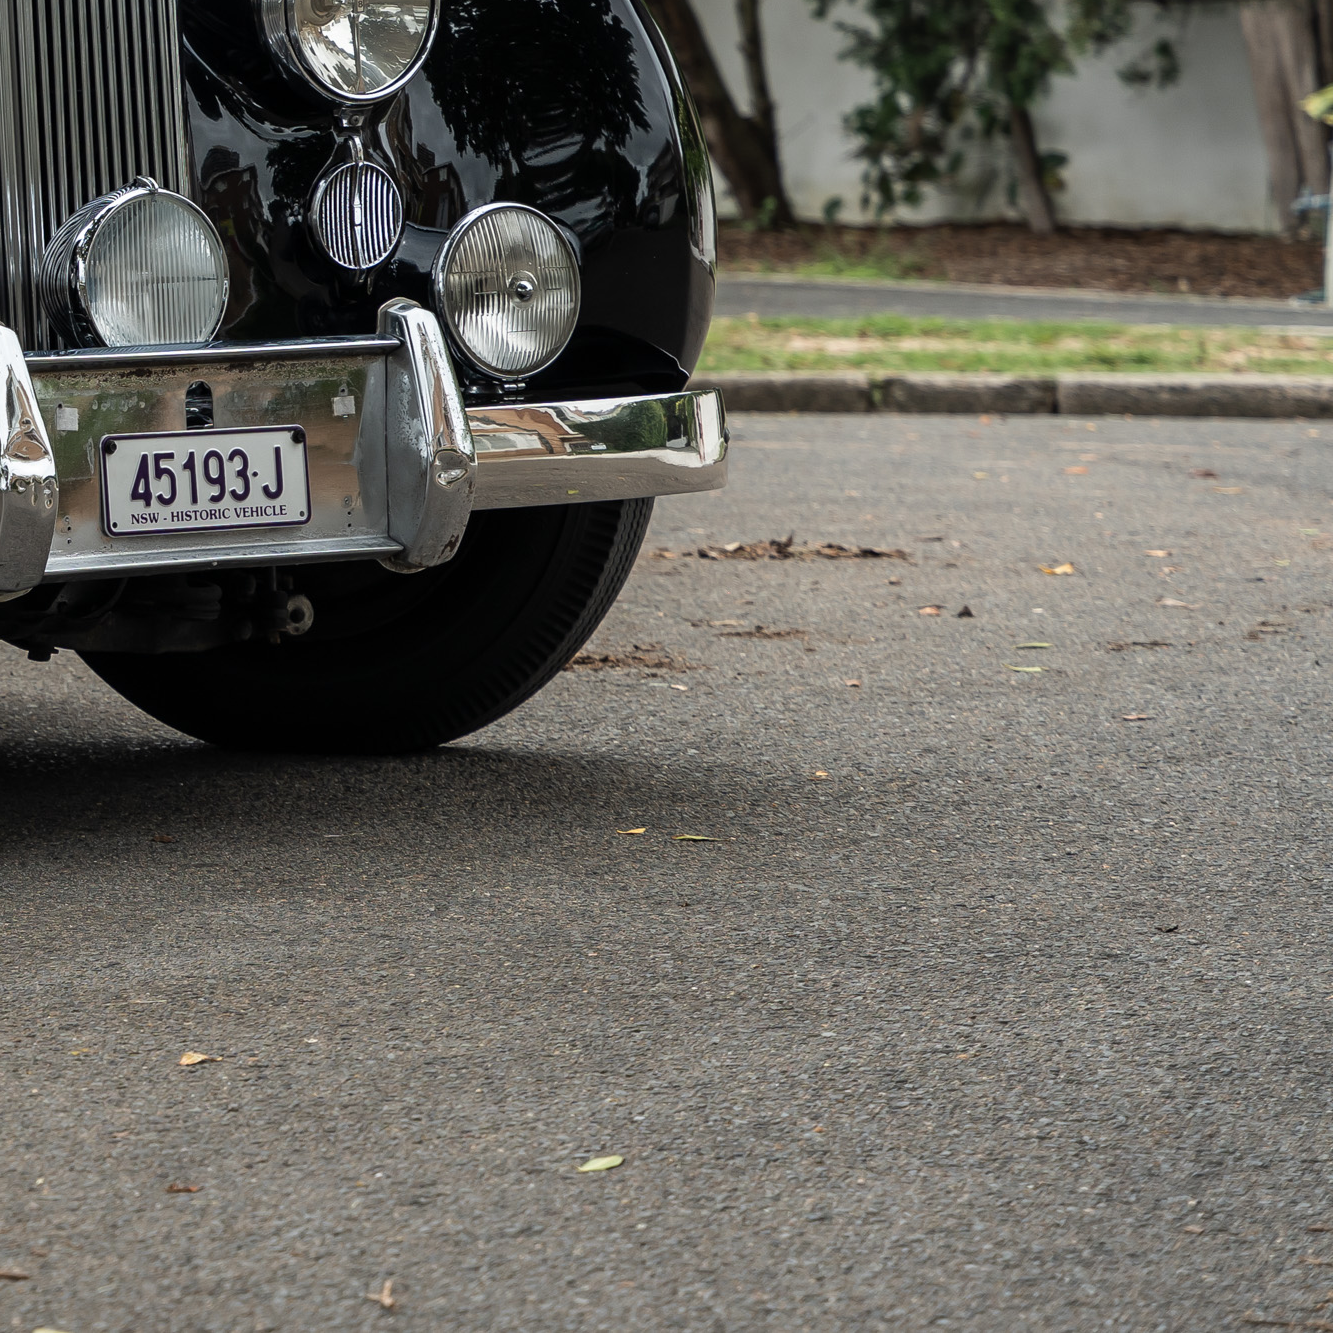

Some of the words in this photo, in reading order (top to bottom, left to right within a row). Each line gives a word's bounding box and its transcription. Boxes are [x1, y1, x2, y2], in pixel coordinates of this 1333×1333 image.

[131, 512, 160, 524] NSW
[171, 507, 231, 523] HISTORIC
[233, 504, 288, 519] VEHICLE
